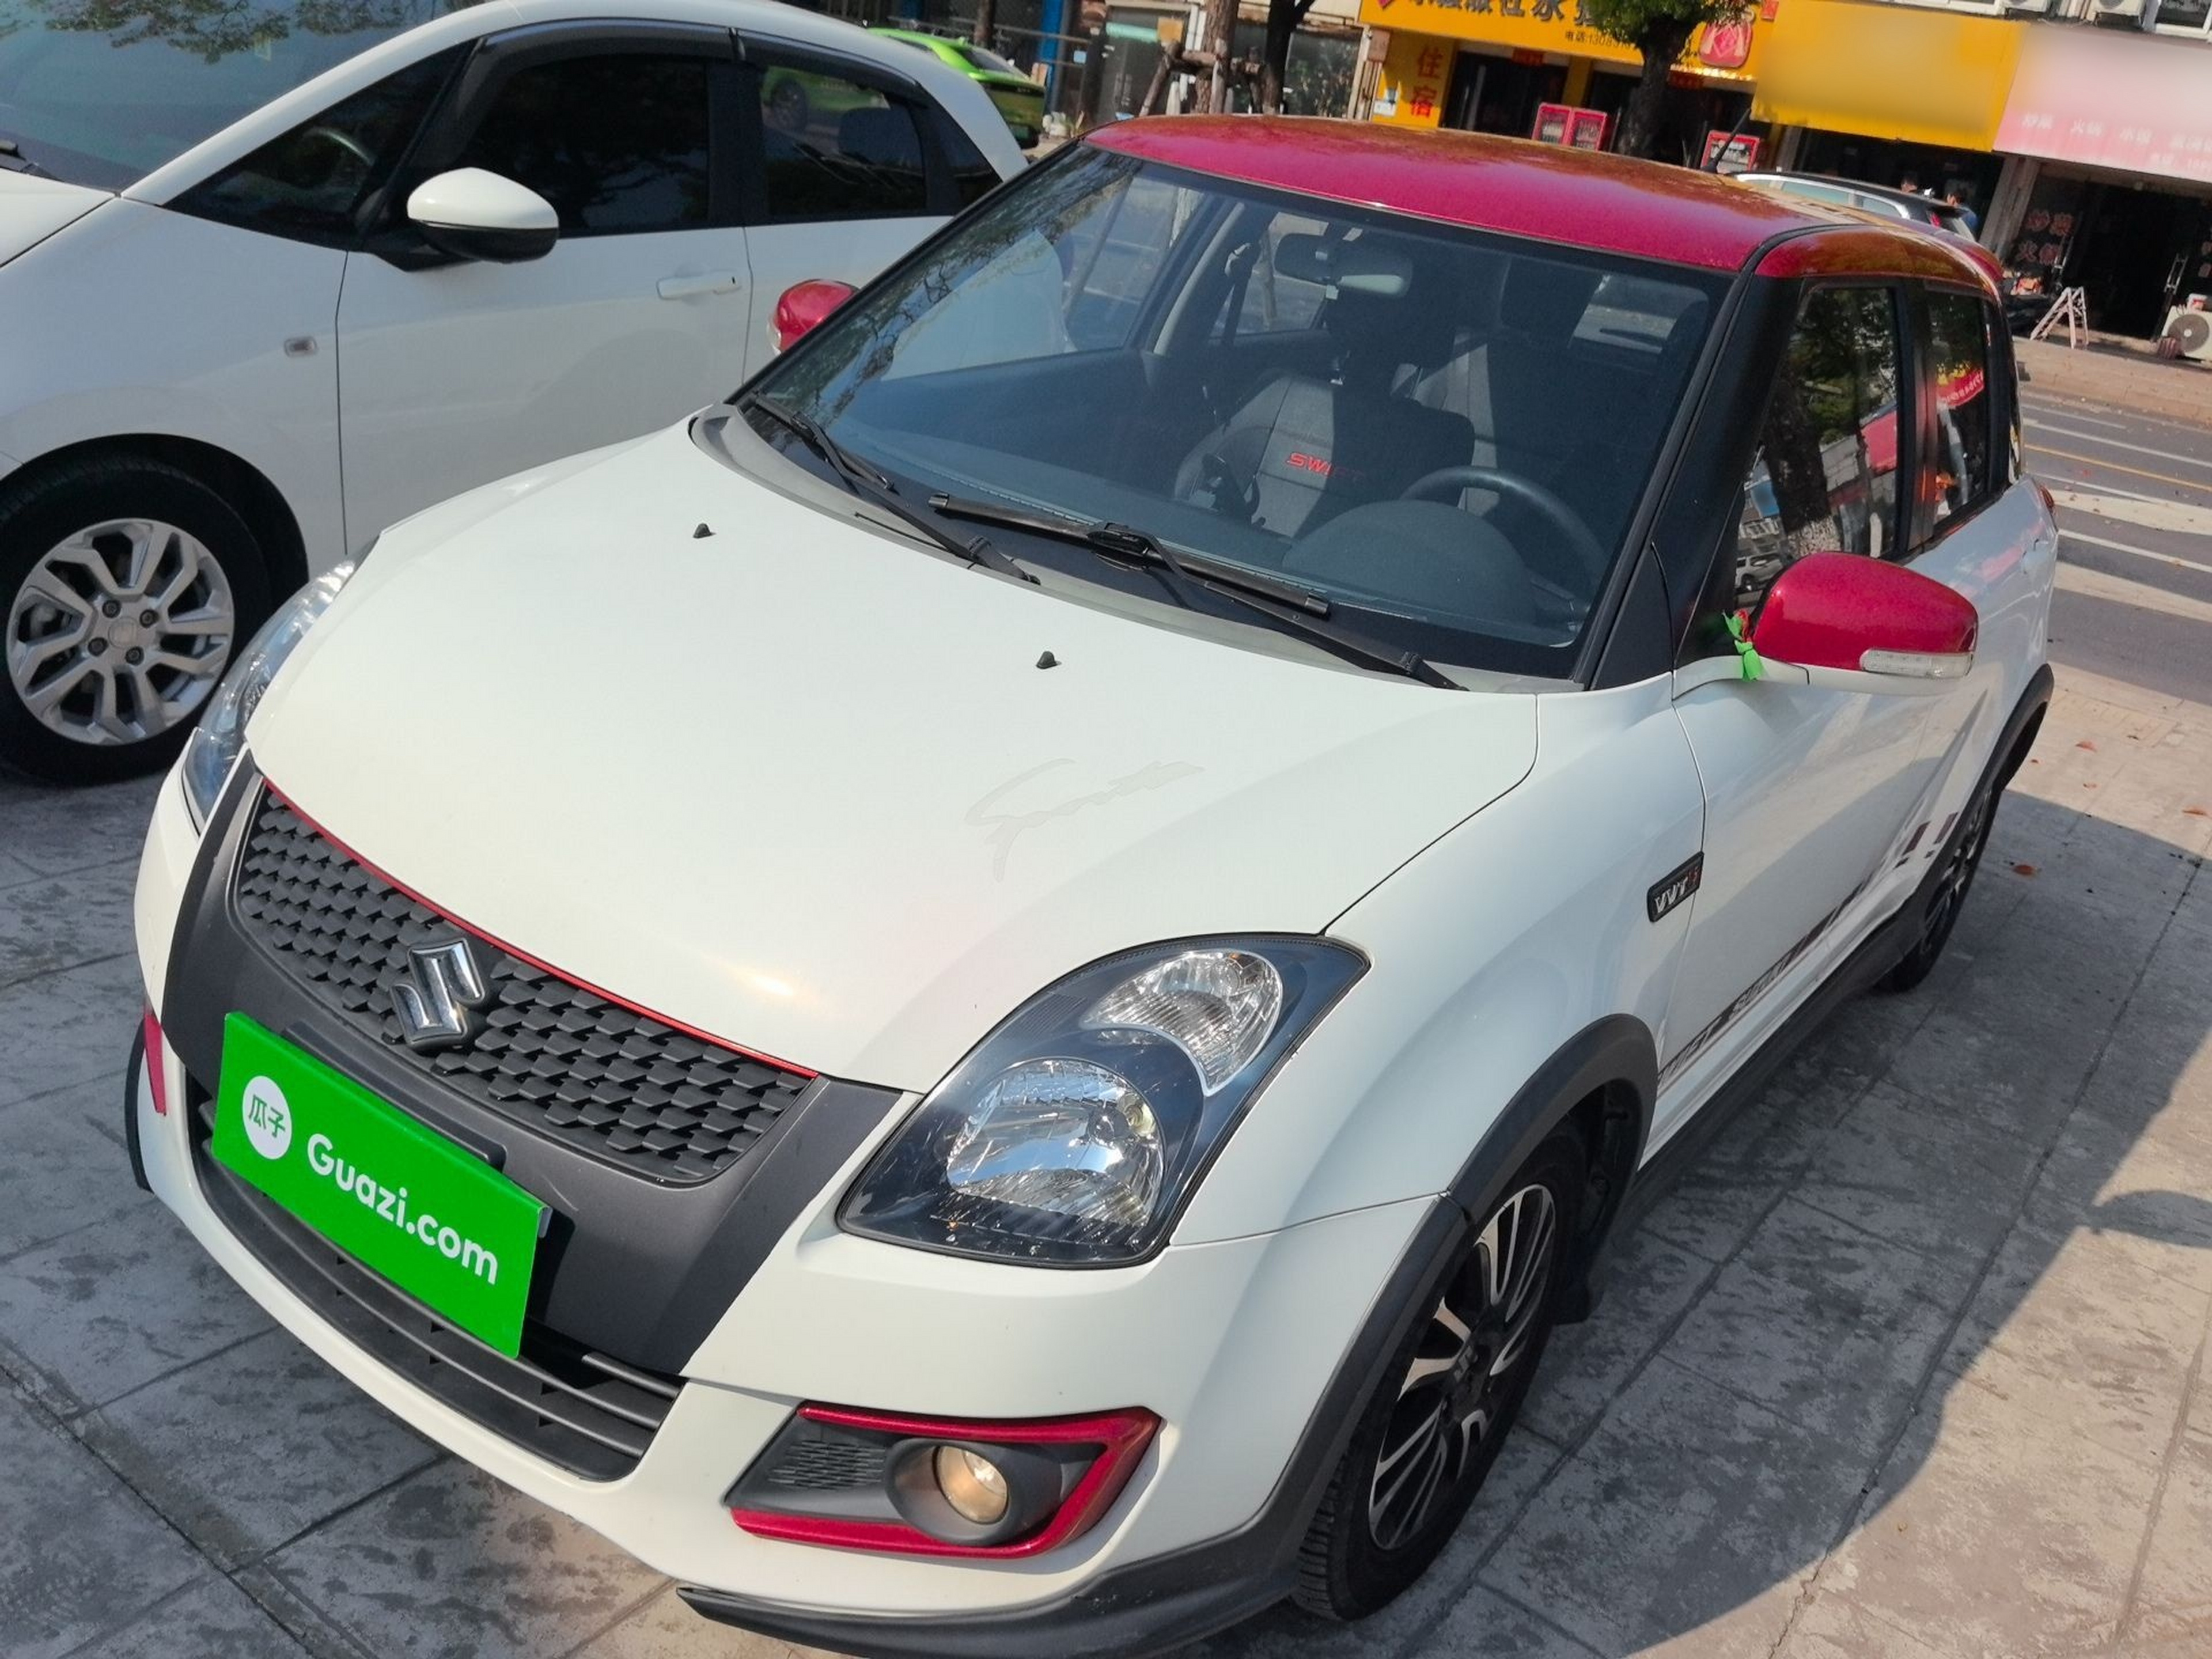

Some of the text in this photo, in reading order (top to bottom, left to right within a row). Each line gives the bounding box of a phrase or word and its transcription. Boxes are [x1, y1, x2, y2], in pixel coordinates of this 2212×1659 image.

[1408, 46, 1443, 118] 住宿
[248, 1093, 286, 1138] 瓜子
[307, 1133, 499, 1285] Guazi.com
